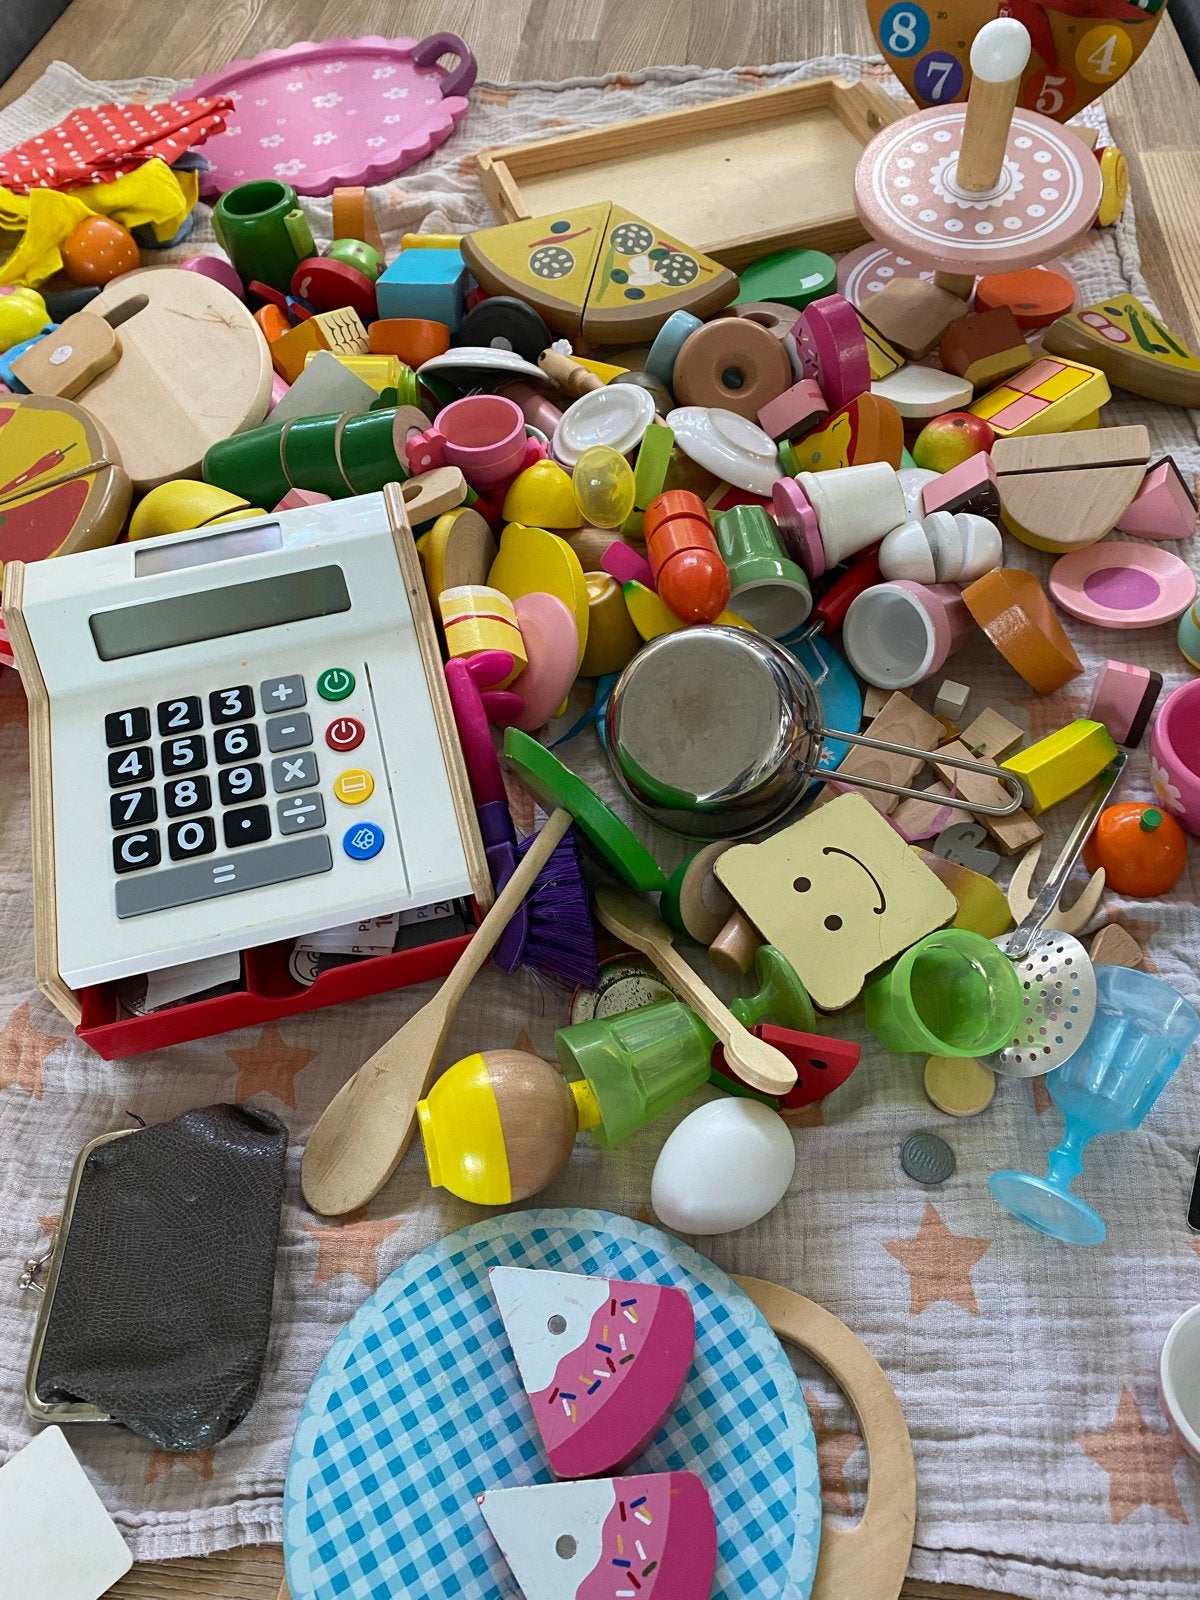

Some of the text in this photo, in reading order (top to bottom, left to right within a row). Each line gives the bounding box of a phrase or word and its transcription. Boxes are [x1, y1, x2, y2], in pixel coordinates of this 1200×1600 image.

[889, 11, 916, 52] 8
[1087, 34, 1117, 76] 4
[926, 60, 953, 100] 7
[1036, 75, 1066, 115] 5
[168, 702, 189, 727] 2
[221, 690, 242, 715] 3
[119, 713, 132, 737] 1
[173, 740, 193, 765] 5
[225, 729, 248, 754] 6
[118, 751, 142, 775] 4
[175, 781, 197, 807] 8
[229, 768, 252, 794] 9
[120, 792, 141, 820] 7
[121, 835, 149, 863] C
